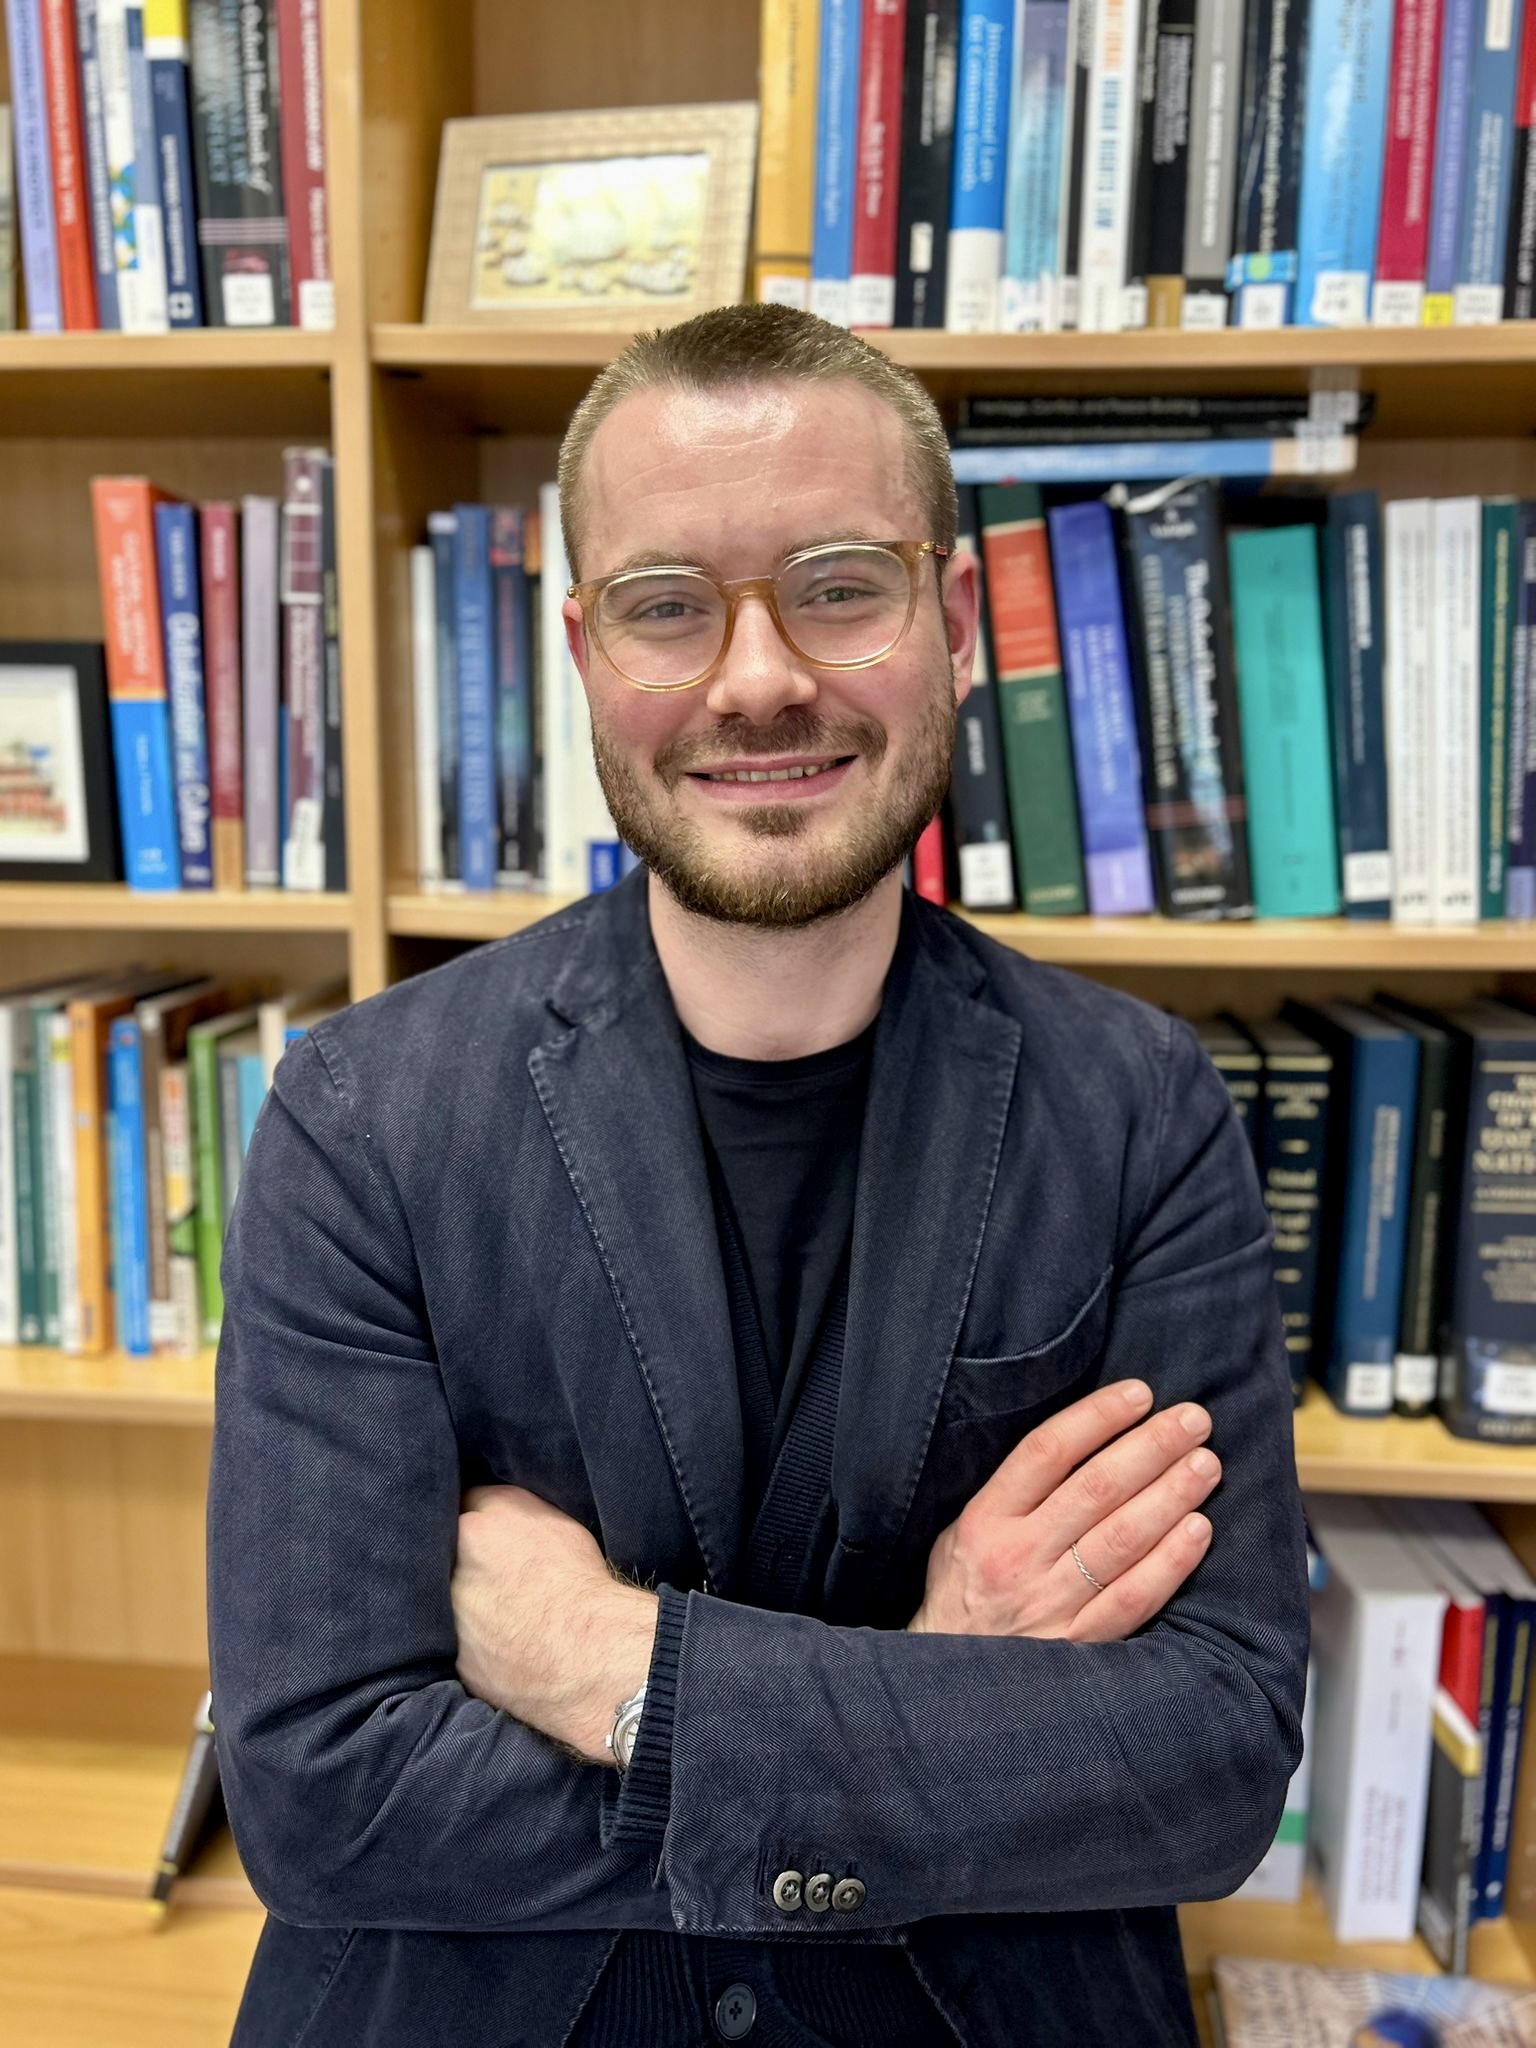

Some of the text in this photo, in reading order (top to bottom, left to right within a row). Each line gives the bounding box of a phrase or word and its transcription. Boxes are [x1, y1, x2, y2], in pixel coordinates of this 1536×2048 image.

[963, 44, 983, 130] Common
[979, 22, 1002, 182] International Law
[1101, 79, 1120, 130] HUMAN
[960, 131, 979, 192] Goods
[1098, 139, 1117, 191] RIGHTS
[1096, 197, 1114, 228] LAW
[1189, 559, 1209, 596] The
[1191, 597, 1213, 658] Oxford
[461, 622, 484, 713] FUTURE
[169, 611, 208, 853] Globalization and Culture
[1195, 659, 1218, 750] Handbook
[466, 750, 488, 822] RUINS
